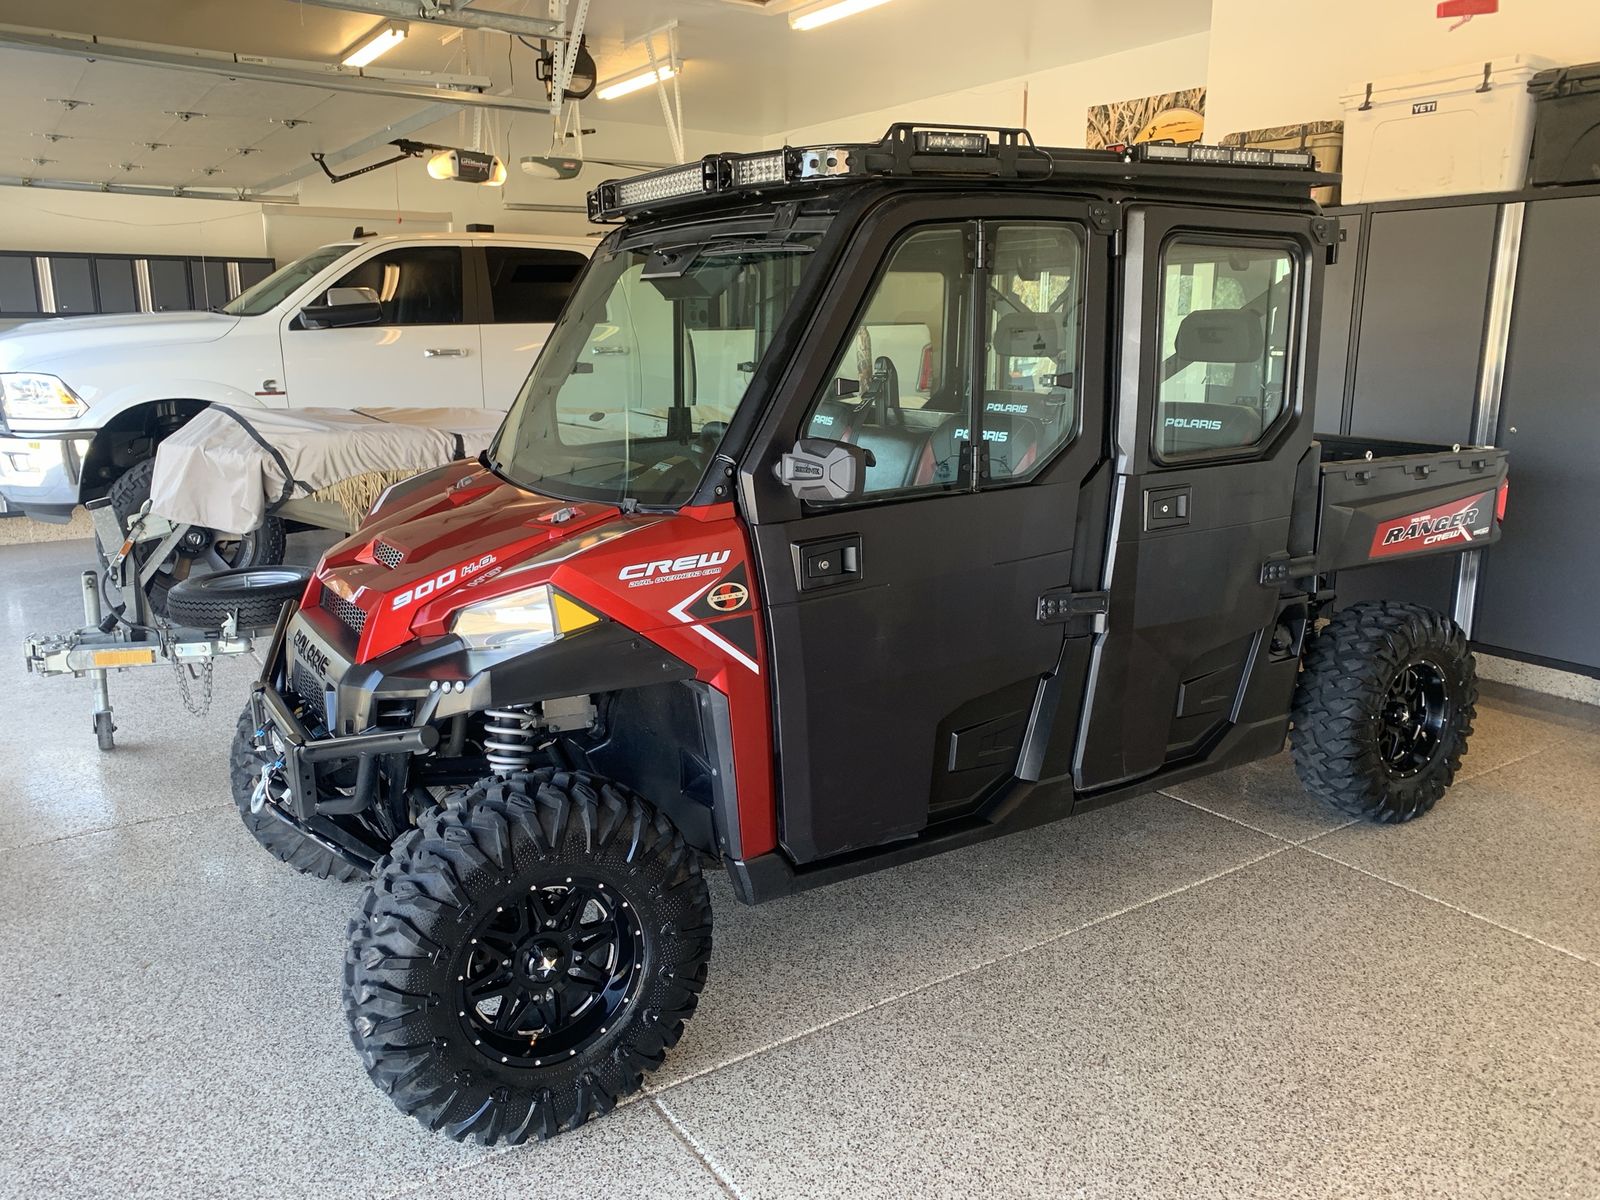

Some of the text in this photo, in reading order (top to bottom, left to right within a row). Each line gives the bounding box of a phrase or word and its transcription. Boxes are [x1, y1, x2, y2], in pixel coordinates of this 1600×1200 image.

[1413, 102, 1436, 113] YETI
[987, 403, 1029, 413] POLARIS
[813, 414, 834, 426] ARIS
[1165, 418, 1222, 430] POLARIS
[1382, 508, 1479, 545] RANGER
[1423, 530, 1462, 545] CREW
[618, 549, 732, 581] CREW
[393, 569, 457, 611] 900
[461, 554, 497, 577] H.O.
[294, 629, 330, 680] POLARIS
